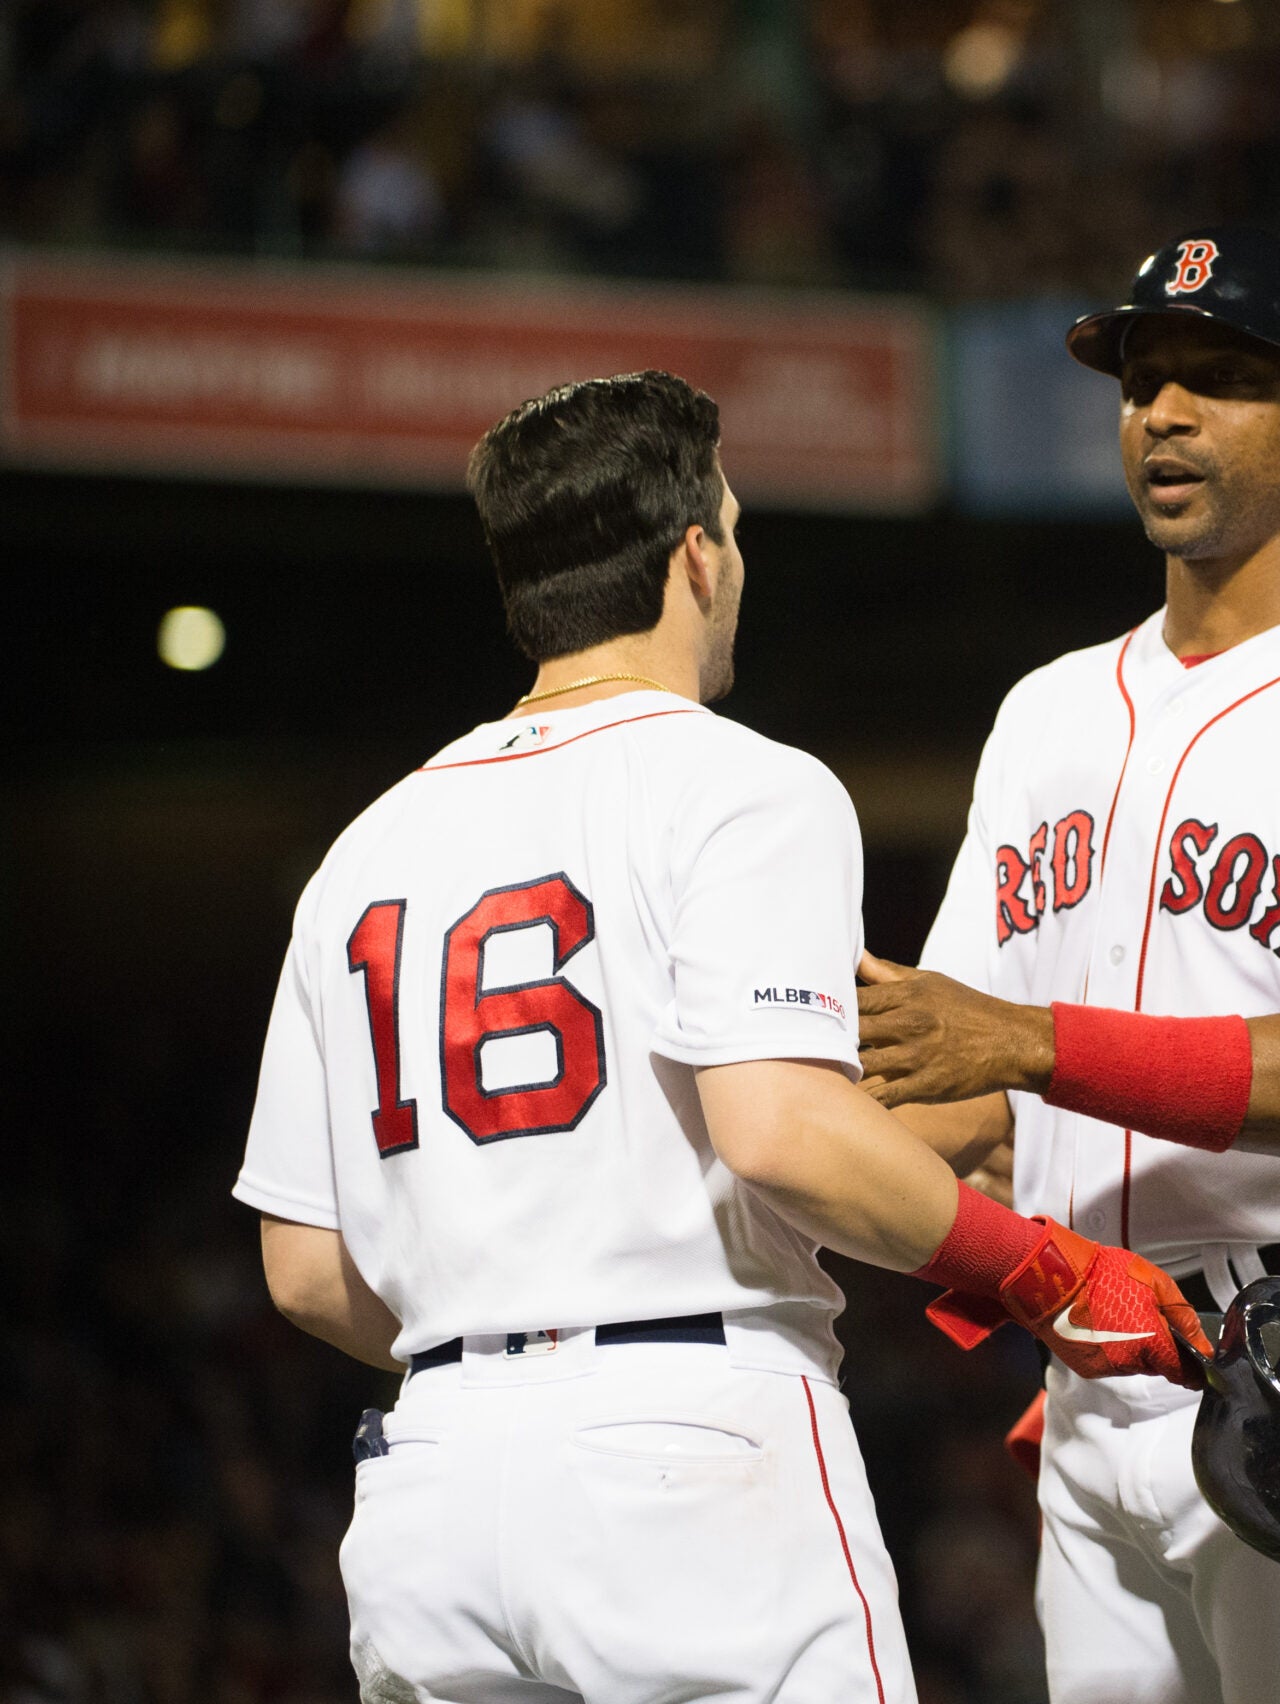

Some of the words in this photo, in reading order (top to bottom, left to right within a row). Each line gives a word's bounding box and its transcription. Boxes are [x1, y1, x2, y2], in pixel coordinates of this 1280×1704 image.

[1165, 240, 1219, 296] B
[996, 809, 1096, 948] RED
[347, 871, 607, 1159] 16
[754, 987, 799, 1003] MLB
[827, 996, 845, 1019] 150
